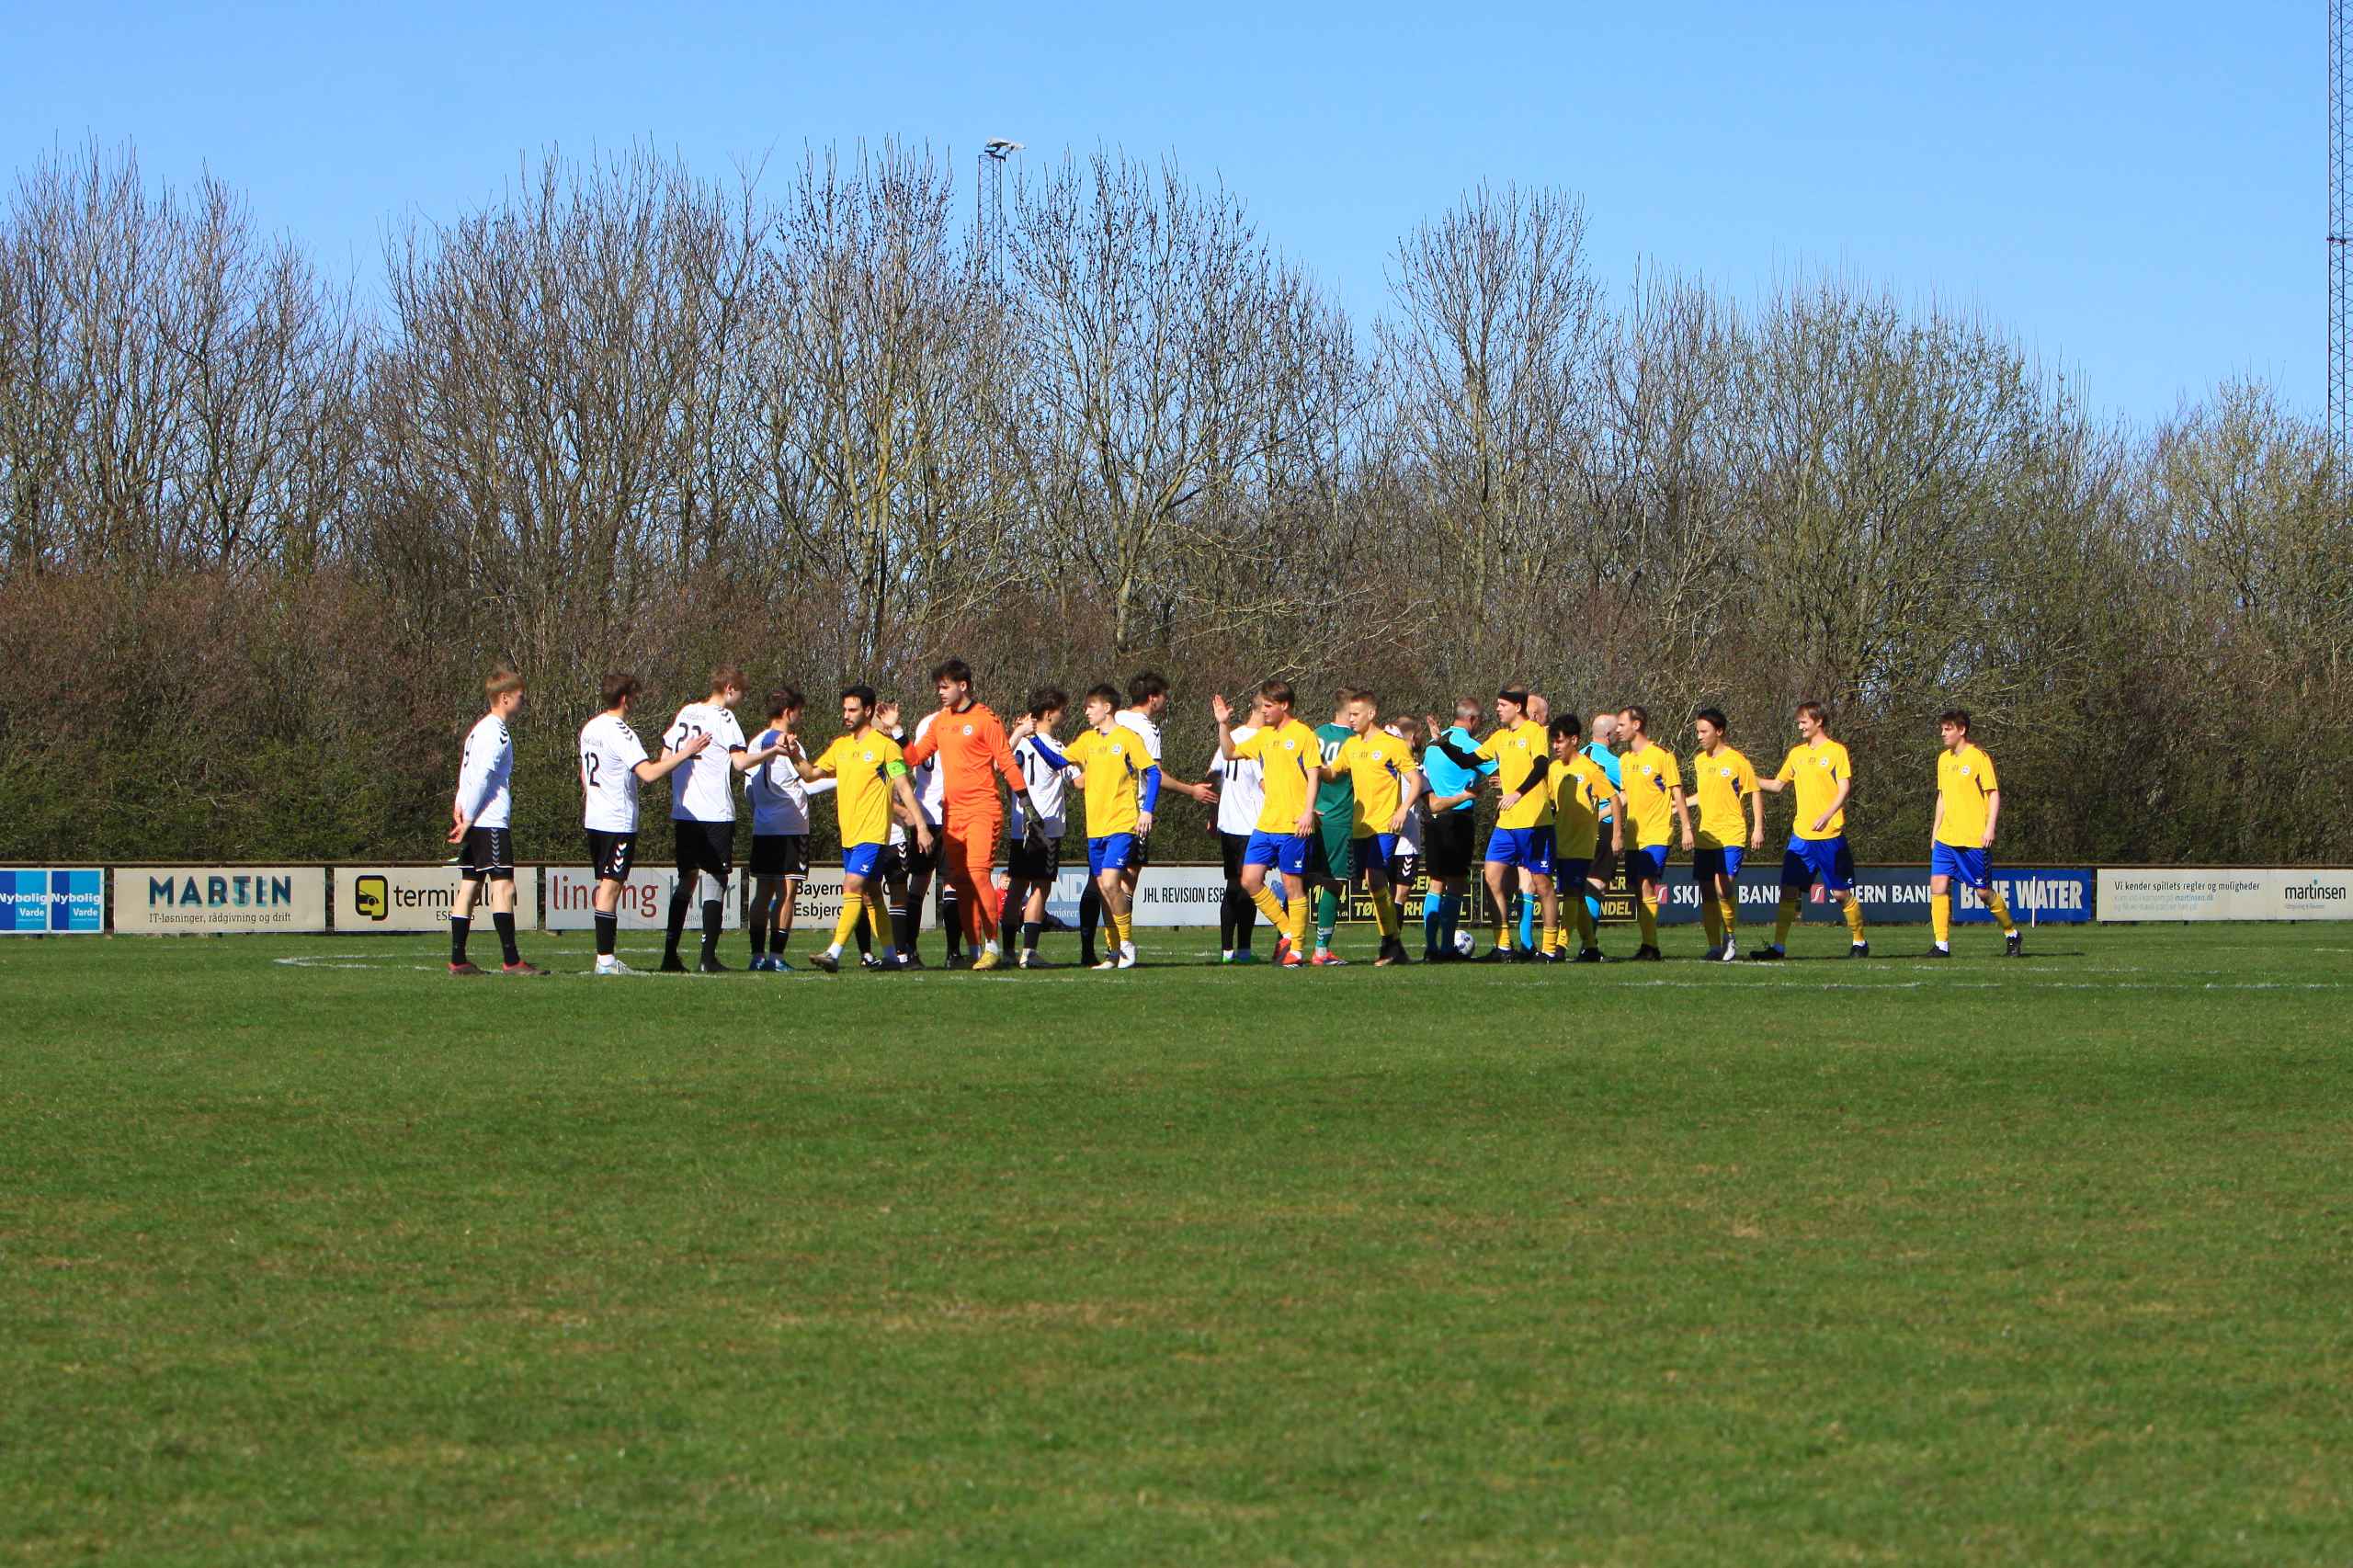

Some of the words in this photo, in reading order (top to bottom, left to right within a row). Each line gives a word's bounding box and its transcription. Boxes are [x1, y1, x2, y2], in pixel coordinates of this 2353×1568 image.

[585, 751, 600, 788] 12
[796, 881, 844, 899] Bayern
[2114, 881, 2123, 891] Vi
[2125, 881, 2151, 891] kender
[2153, 881, 2181, 892] spillets
[2183, 881, 2205, 892] regler
[2207, 883, 2217, 892] og
[2218, 881, 2260, 892] muligheder
[2285, 878, 2347, 900] martinsen
[0, 892, 48, 905] Nybolig
[51, 892, 101, 905] Nybolig
[1142, 887, 1159, 903] JHL
[1162, 887, 1205, 903] REVISION
[1892, 885, 1930, 903] BAN
[2016, 880, 2083, 909] WATER
[19, 908, 45, 916] Varde
[74, 908, 98, 916] Varde
[209, 913, 256, 923] rådgivning
[257, 915, 270, 923] og
[273, 913, 291, 922] drift
